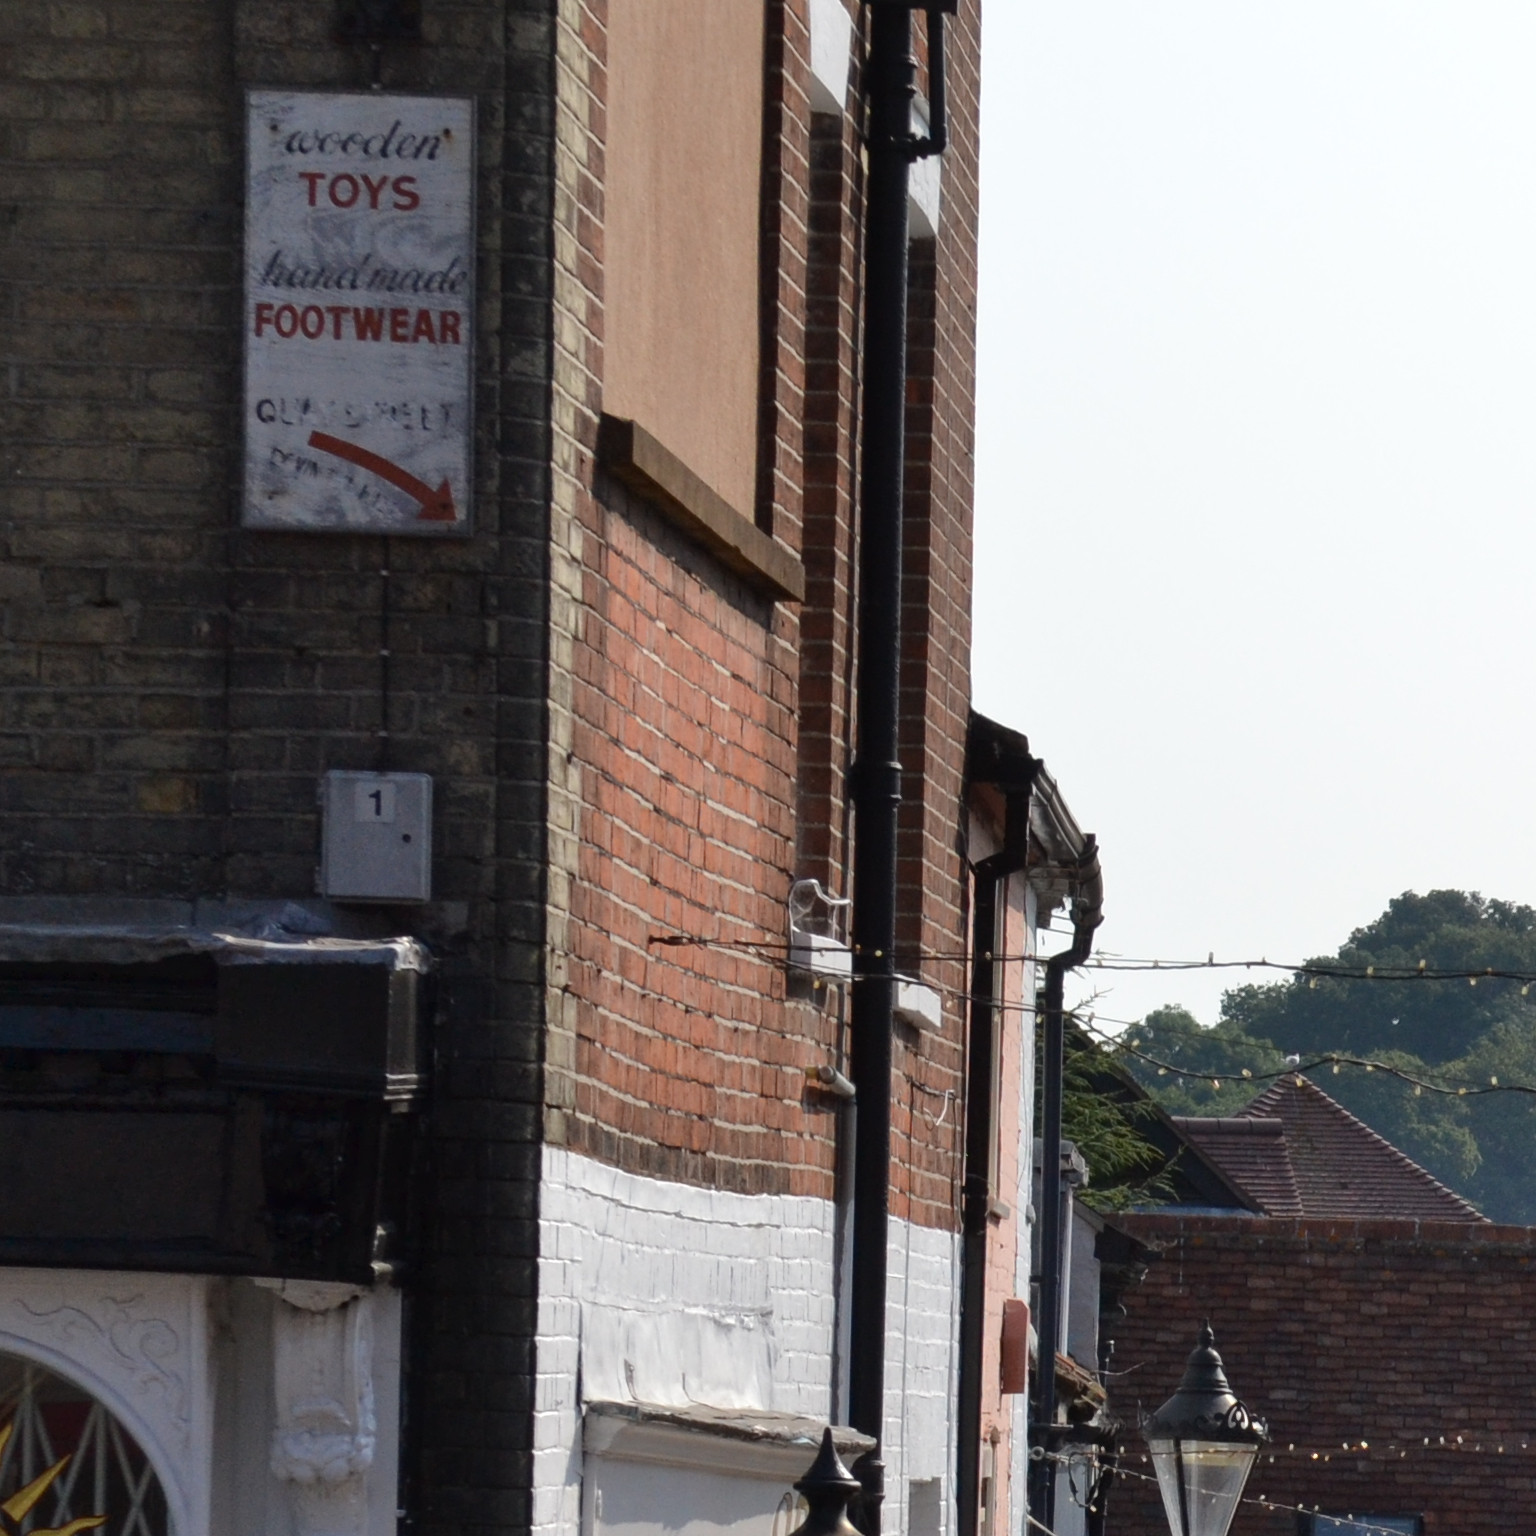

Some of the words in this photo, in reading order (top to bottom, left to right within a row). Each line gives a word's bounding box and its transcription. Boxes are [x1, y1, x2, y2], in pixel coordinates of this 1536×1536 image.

[300, 171, 421, 212] TOYS
[254, 303, 462, 345] FOOTWEAR
[368, 789, 382, 817] 1
